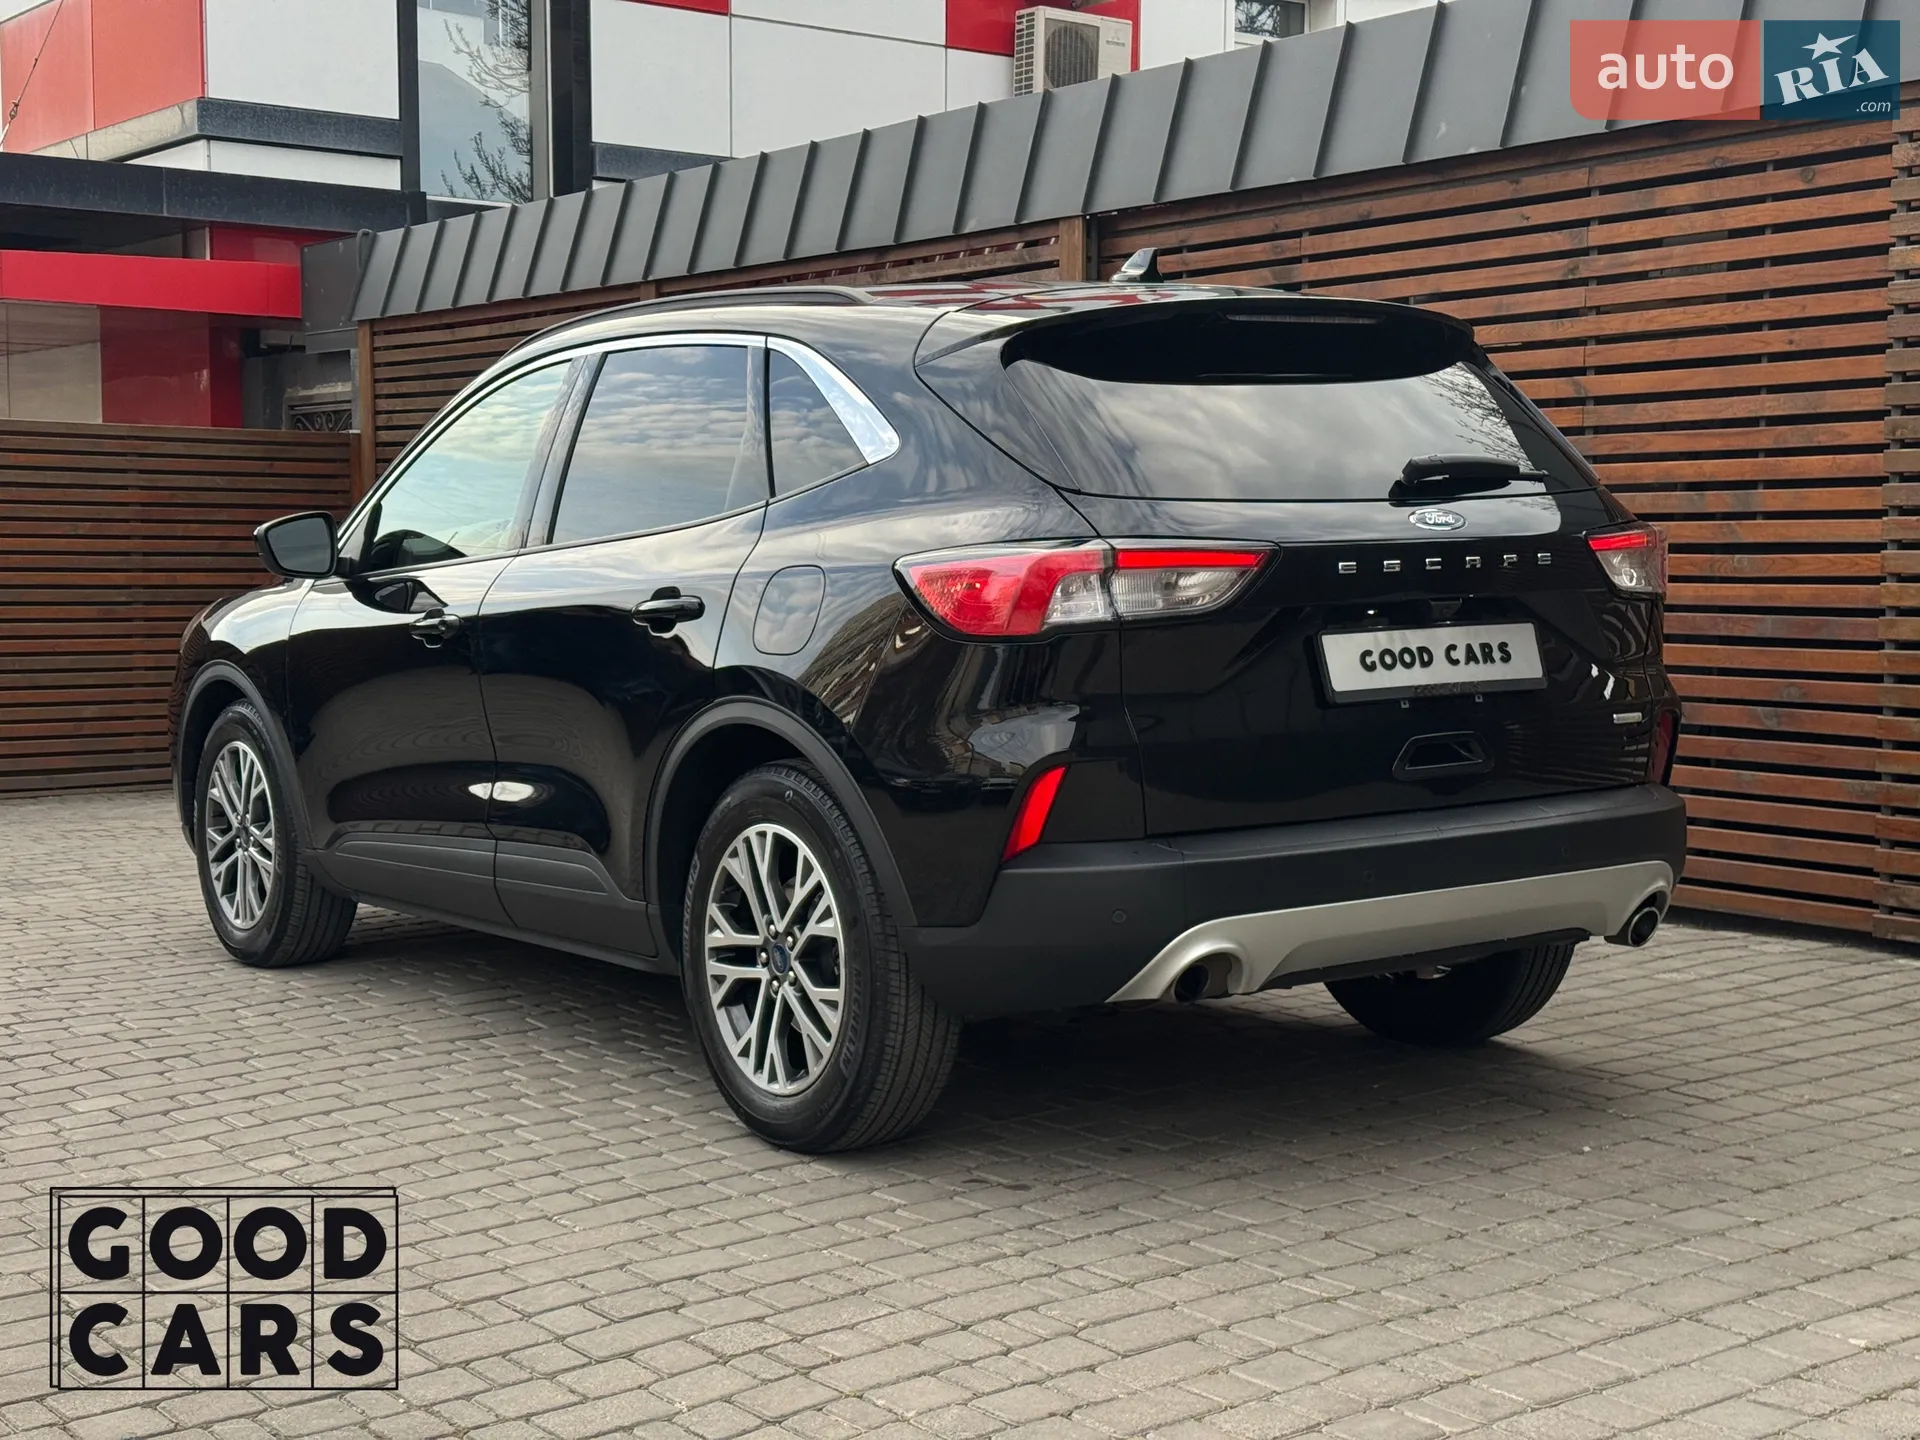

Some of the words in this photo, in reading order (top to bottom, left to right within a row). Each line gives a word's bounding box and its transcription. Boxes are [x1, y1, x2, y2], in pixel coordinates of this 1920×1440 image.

[1424, 512, 1455, 525] Ford
[1338, 552, 1552, 574] ESCAPE
[1359, 646, 1434, 673] GOOD
[1444, 641, 1512, 666] CARS
[842, 967, 863, 1070] MICHELIN
